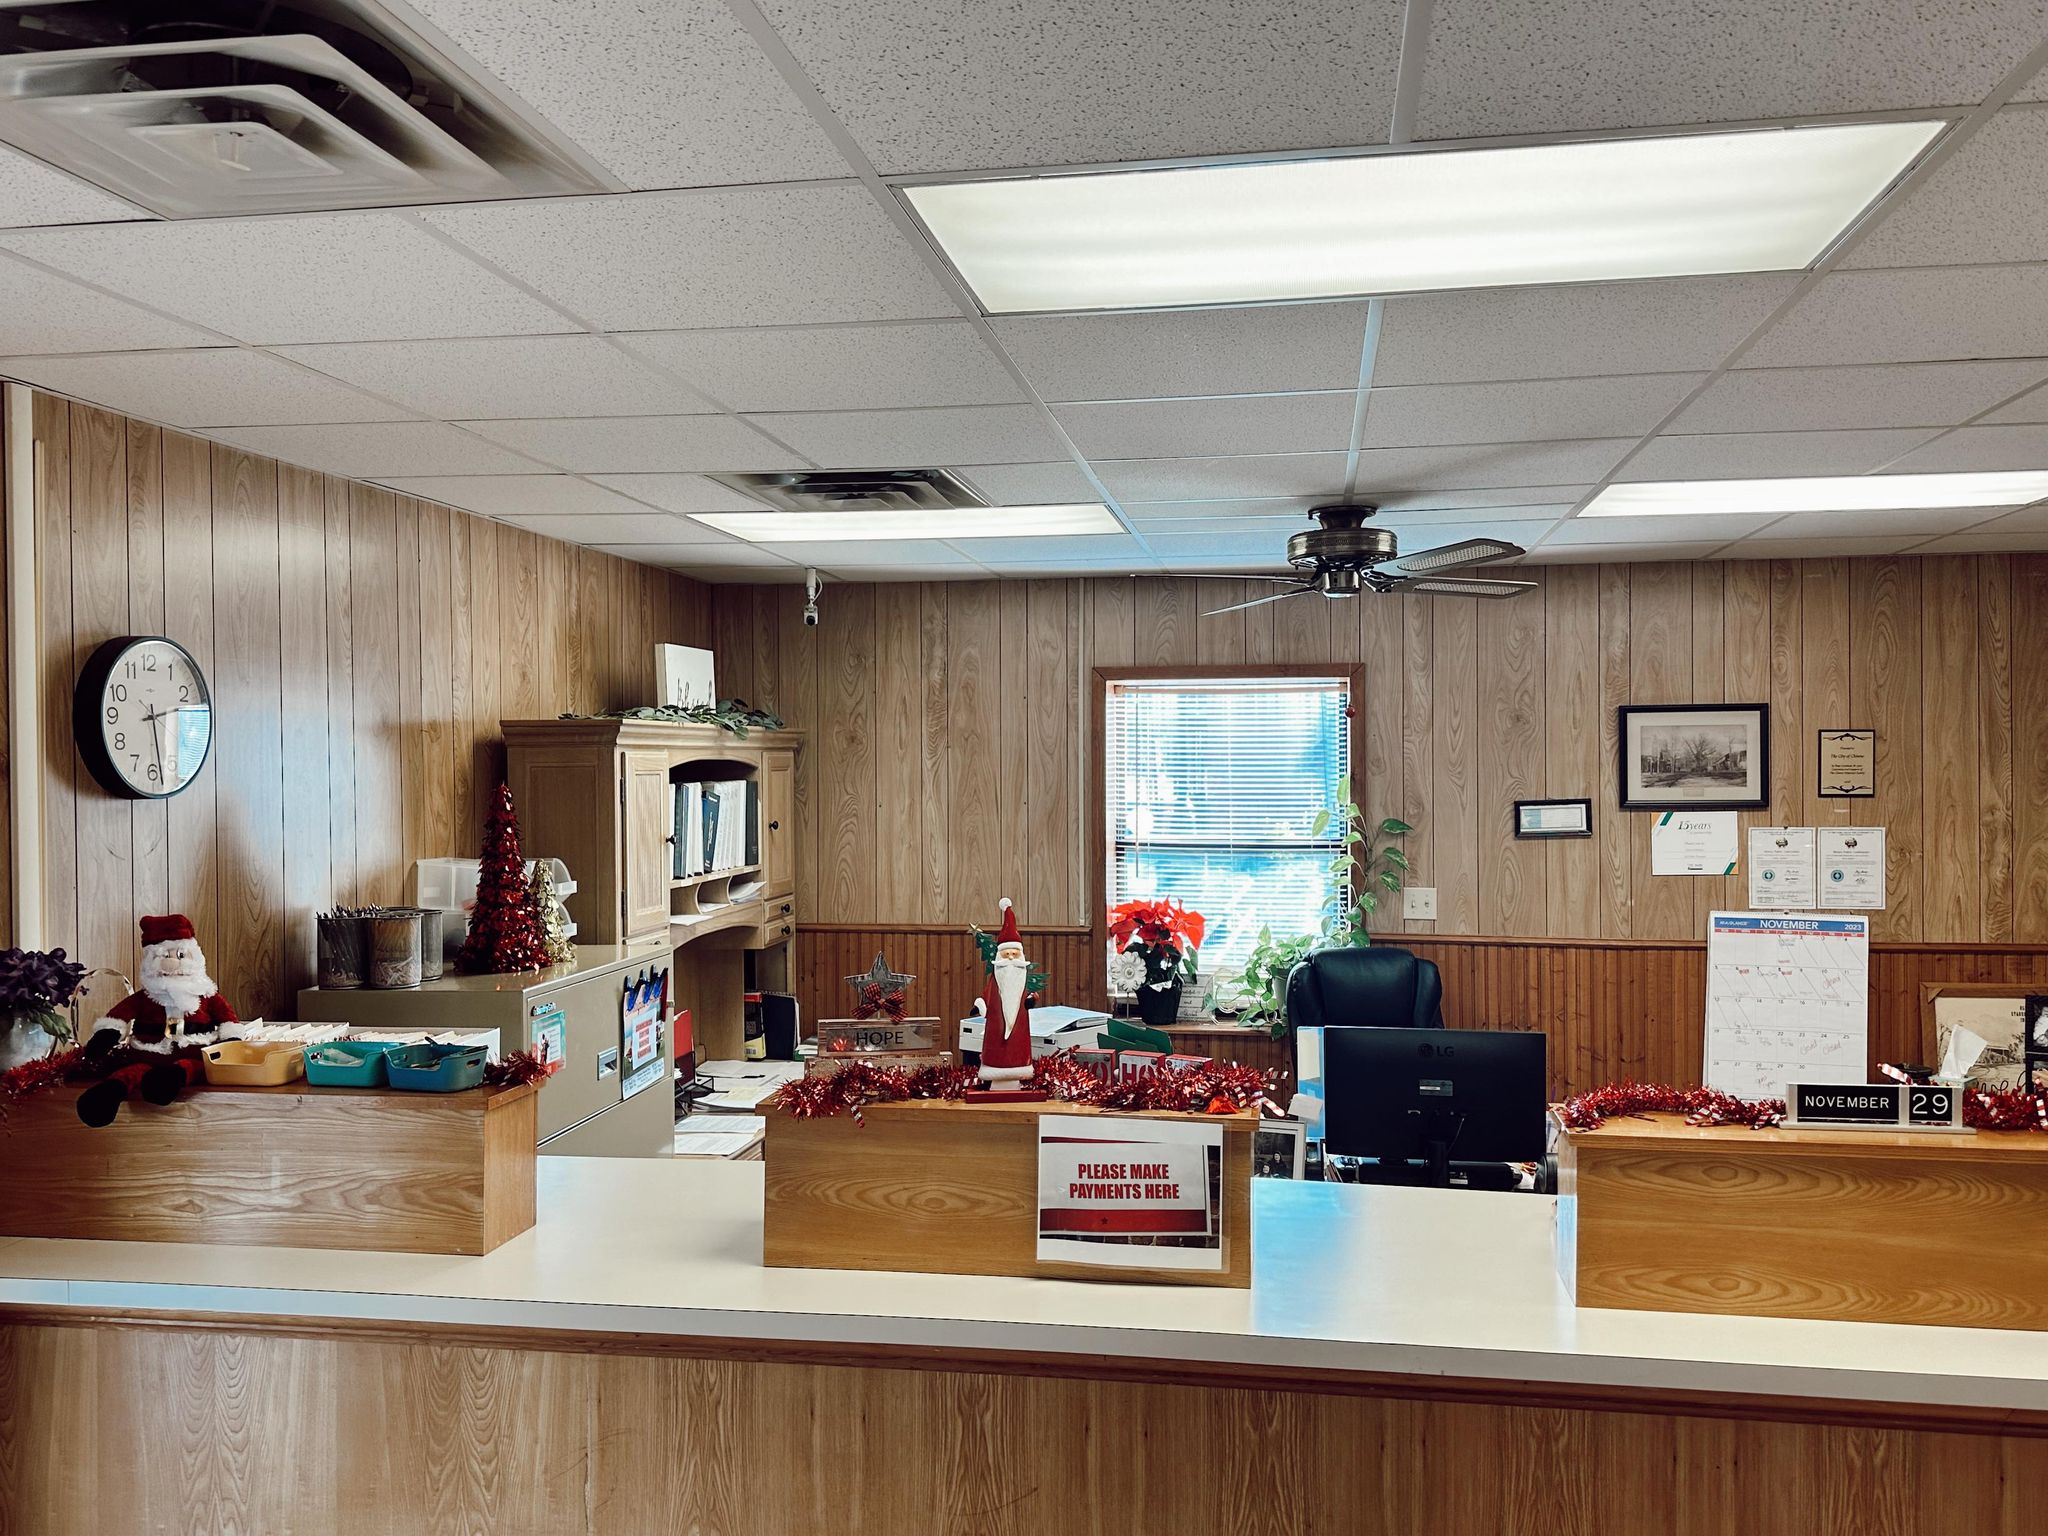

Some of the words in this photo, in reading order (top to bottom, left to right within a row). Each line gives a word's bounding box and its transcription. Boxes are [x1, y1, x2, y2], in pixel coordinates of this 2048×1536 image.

[125, 661, 137, 679] 11
[141, 653, 157, 672] 12
[168, 663, 173, 681] 1
[109, 683, 127, 702] 10
[178, 685, 189, 703] 2
[106, 706, 119, 725] 9
[114, 732, 126, 751] 8
[130, 754, 140, 773] 7
[147, 763, 158, 781] 6
[1759, 919, 1819, 930] NOVEMBER
[1844, 923, 1862, 931] 2023
[856, 1031, 905, 1046] HOPE
[1436, 1046, 1455, 1057] LG
[1804, 1095, 1890, 1110] NOVEMBER
[1911, 1093, 1950, 1115] 29
[1078, 1163, 1127, 1180] PLEASE
[1129, 1163, 1170, 1180] MAKE
[1069, 1183, 1142, 1200] PAYMENTS
[1144, 1183, 1180, 1200] HERE
